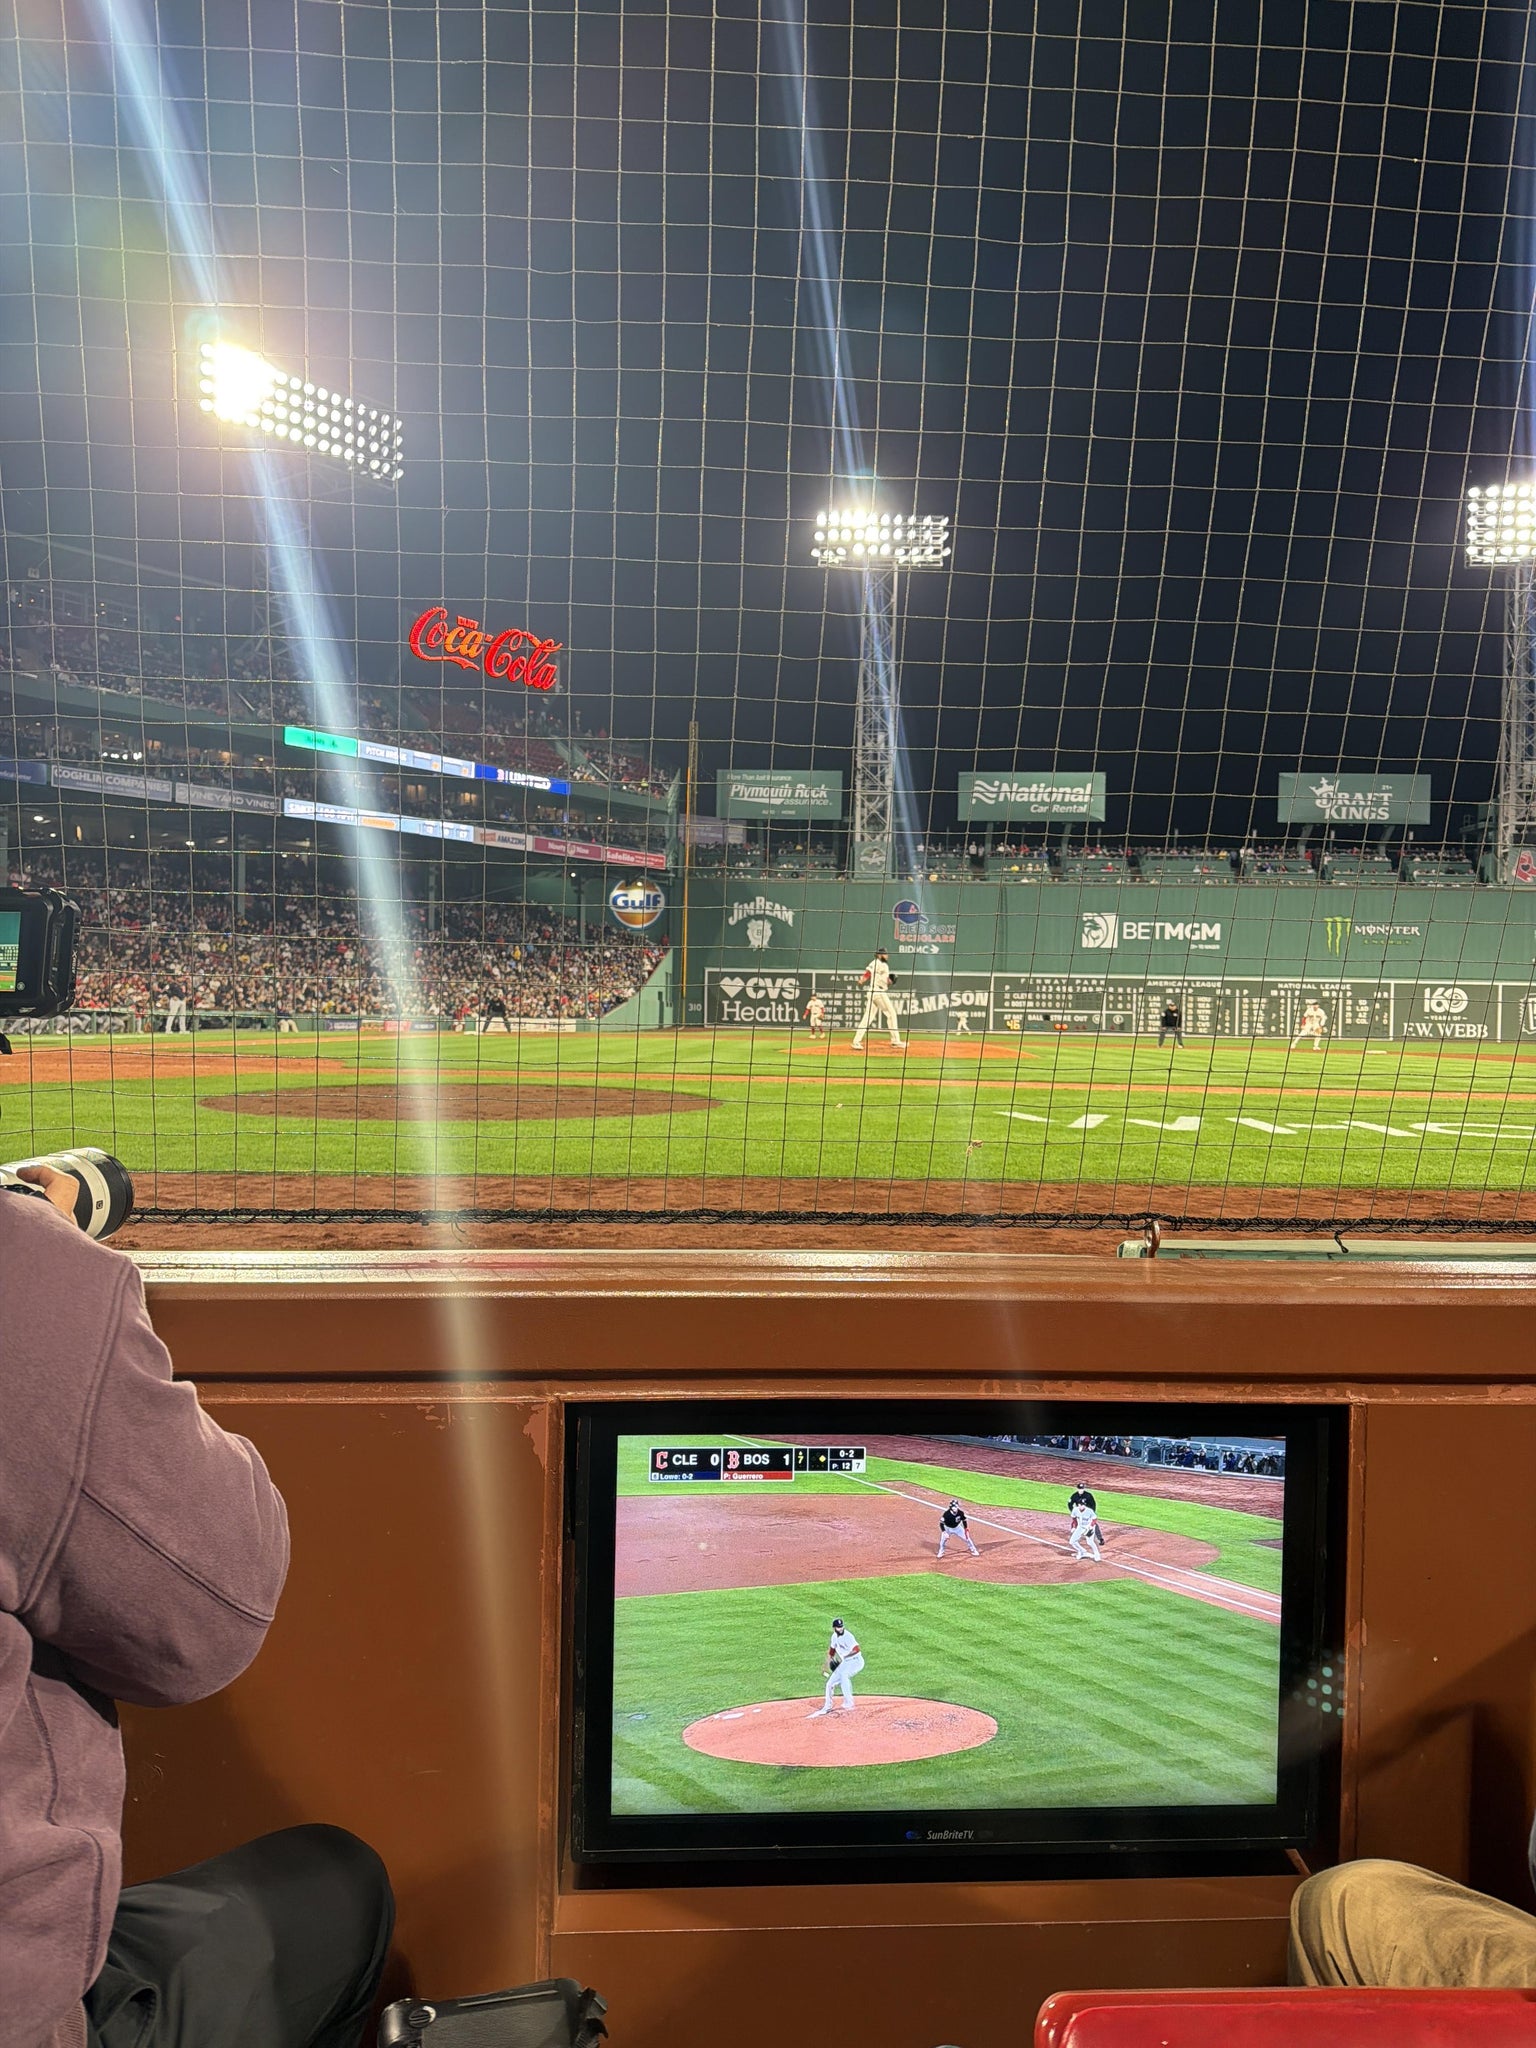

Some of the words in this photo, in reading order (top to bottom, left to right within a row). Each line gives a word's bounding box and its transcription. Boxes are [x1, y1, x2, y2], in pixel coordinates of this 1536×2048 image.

[54, 769, 102, 784] COGHLIN
[106, 776, 170, 792] COMPANIES
[730, 783, 792, 799] Plymouth
[795, 784, 828, 798] Rock
[1000, 782, 1092, 802] National
[190, 789, 244, 806] VINEYARD
[246, 798, 277, 810] VINES
[1315, 791, 1393, 808] DRAFT
[1030, 804, 1048, 813] Car
[1052, 805, 1087, 813] Rental
[1324, 807, 1389, 820] KINGS
[612, 893, 661, 909] Gulf
[899, 925, 926, 934] RED
[929, 925, 956, 934] SOX
[1122, 922, 1221, 940] BETMGM
[1354, 925, 1420, 936] MONSTER
[899, 933, 956, 943] SCHOLARS
[746, 978, 800, 1000] CVS
[1424, 987, 1468, 1013] 160
[688, 1003, 702, 1012] 310
[722, 1001, 800, 1022] Health
[1006, 1020, 1020, 1030] 46
[1437, 1023, 1488, 1038] WEBB
[672, 1454, 698, 1465] CLE
[710, 1454, 720, 1466] 0
[744, 1454, 770, 1465] BOS
[783, 1454, 790, 1466] 1
[798, 1456, 804, 1464] 7
[842, 1462, 850, 1470] 12
[927, 1830, 974, 1840] SunBriteTV
